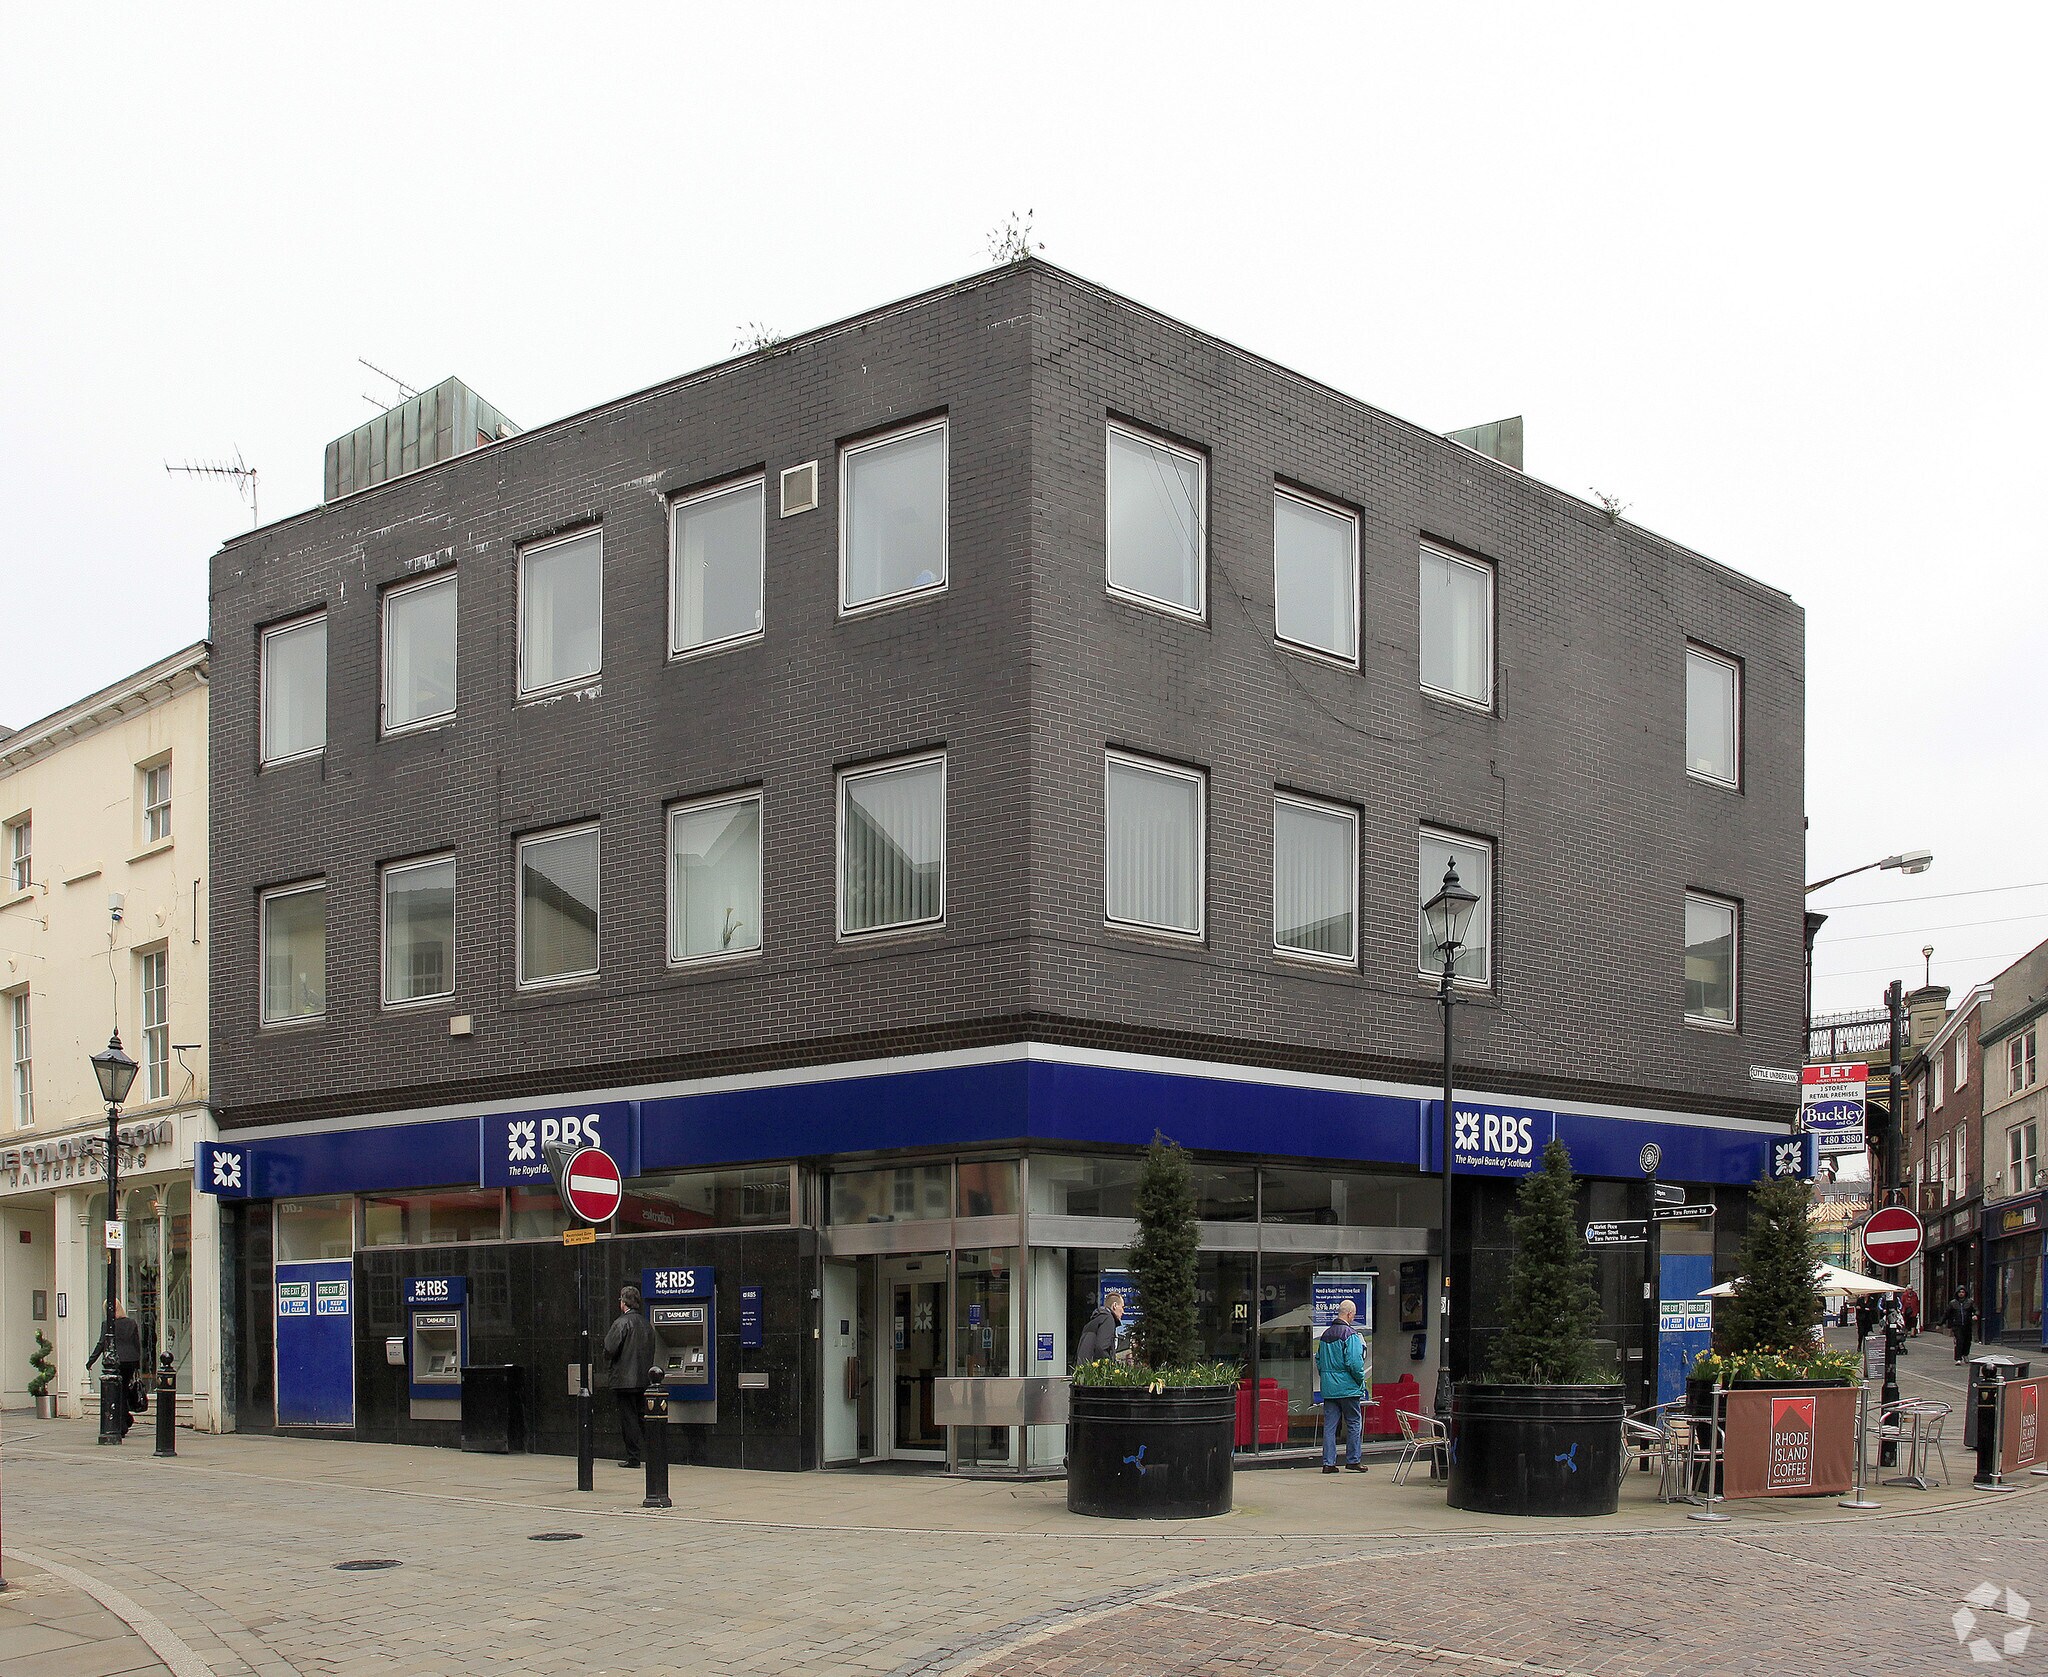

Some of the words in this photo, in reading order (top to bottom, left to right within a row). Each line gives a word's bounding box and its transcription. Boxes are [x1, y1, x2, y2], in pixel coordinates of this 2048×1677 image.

[1770, 1072, 1797, 1081] UNDERBANK
[1820, 1066, 1852, 1078] LET
[1806, 1105, 1863, 1122] Buckley
[105, 1121, 173, 1153] OOM
[541, 1114, 601, 1158] RBS
[1484, 1114, 1532, 1154] RBS
[1824, 1136, 1839, 1144] 480
[1841, 1135, 1861, 1143] 3880
[1455, 1154, 1466, 1164] The
[1467, 1156, 1484, 1167] Royal
[1485, 1157, 1500, 1166] Bank
[1500, 1158, 1507, 1169] of
[1507, 1158, 1532, 1168] Scotland
[509, 1166, 522, 1176] The
[522, 1164, 541, 1177] Royal
[2022, 1206, 2036, 1224] HILL
[670, 1270, 694, 1288] RBS
[282, 1287, 291, 1295] FIRE
[291, 1287, 300, 1295] EXIT
[319, 1286, 329, 1294] FIRE
[427, 1280, 448, 1296] RBS
[1775, 1432, 1809, 1446] RHODE
[1775, 1447, 1808, 1461] ISLAND
[1774, 1462, 1806, 1477] COFFEE
